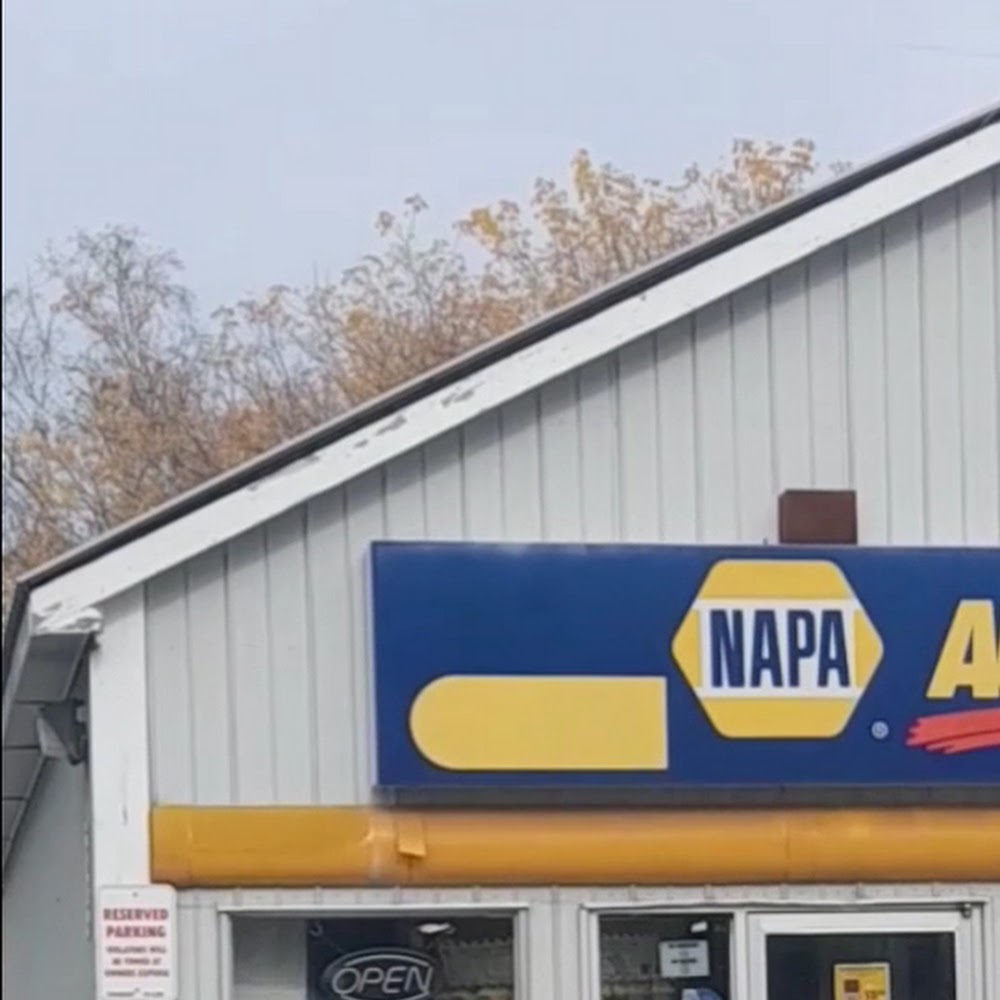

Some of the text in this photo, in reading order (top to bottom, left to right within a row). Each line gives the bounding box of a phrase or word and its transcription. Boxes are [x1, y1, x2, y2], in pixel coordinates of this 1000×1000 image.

[709, 609, 850, 687] NAPA
[103, 908, 168, 920] RESERVED
[106, 926, 166, 938] PARKING
[332, 966, 433, 995] OPEN
